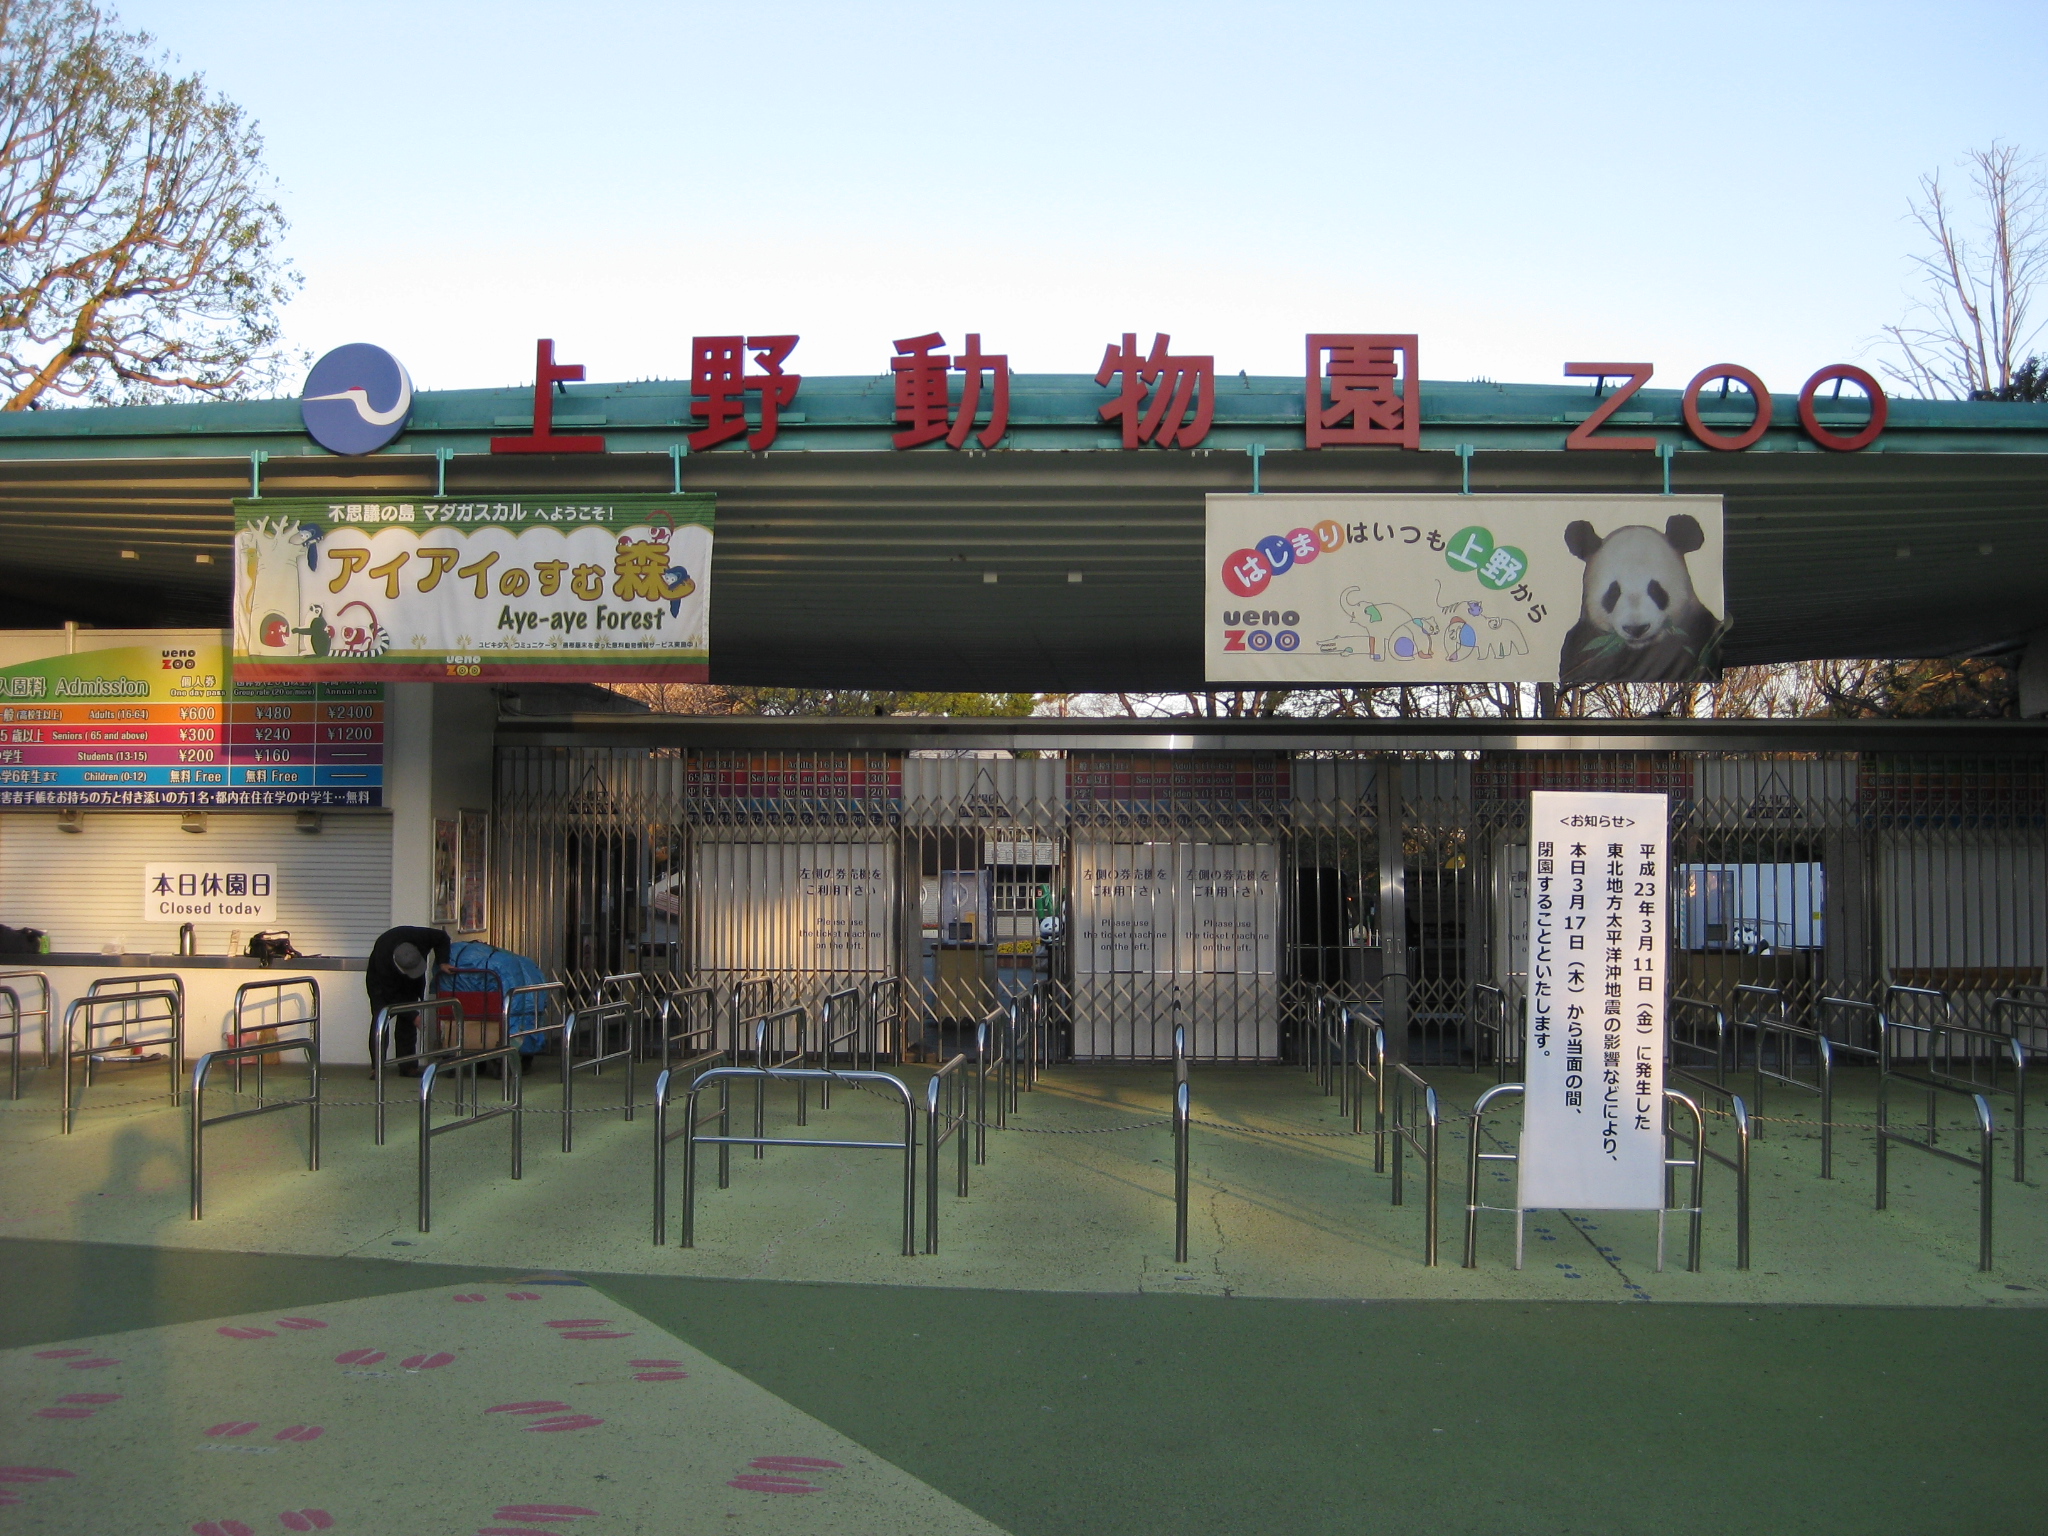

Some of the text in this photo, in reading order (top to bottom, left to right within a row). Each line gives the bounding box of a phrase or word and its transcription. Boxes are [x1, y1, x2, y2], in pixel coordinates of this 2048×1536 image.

[490, 333, 1887, 455] 上野動物園 ZOO
[328, 504, 415, 523] 不思議の島
[423, 503, 526, 522] マダガスカル
[327, 541, 696, 601] アイアイのすむ森
[1233, 519, 1548, 624] はじまりはいつも上野から
[497, 605, 666, 634] Aye-aye Forest
[1223, 610, 1300, 626] ueno
[1223, 630, 1300, 652] ZOO
[161, 650, 196, 658] ueno
[446, 656, 481, 664] ueno
[161, 659, 196, 670] ZOO
[446, 664, 481, 677] ZOO
[55, 676, 150, 698] Admission
[180, 676, 217, 689] 個人券
[170, 689, 226, 699] One day pass
[233, 689, 255, 697] Group
[325, 688, 355, 696] Annual
[0, 708, 15, 722] 般
[88, 710, 149, 721] Adults (16-64)
[179, 707, 215, 721] ¥600
[255, 706, 291, 720] ¥480
[327, 705, 373, 720] ¥2400
[12, 729, 44, 743] 歳以上
[52, 731, 83, 741] Seniors
[90, 731, 102, 741] 65
[104, 732, 119, 741] and
[121, 731, 149, 742] above)
[179, 728, 215, 742] ¥300
[255, 728, 291, 741] ¥240
[327, 727, 372, 741] ¥1200
[0, 749, 24, 764] 学生
[77, 751, 148, 762] Students (13-15)
[178, 749, 214, 763] ¥200
[254, 749, 290, 763] ¥160
[0, 769, 58, 785] 学6年生まで
[84, 771, 147, 782] Children (0-12)
[170, 769, 222, 783] 無料 Free
[245, 769, 298, 783] 無料 Free
[751, 774, 780, 783] Senors
[1136, 775, 1167, 784] Senors
[0, 790, 370, 806] 害者手帳をお持ちの方と付き添いの方1名・都内在住在学の中学生…無料
[151, 873, 271, 897] 本日休園日
[159, 901, 262, 917] Closed today
[1101, 919, 1131, 927] Plase
[1203, 919, 1233, 927] Plase
[844, 930, 881, 938] machne
[1132, 942, 1150, 951] eft.
[1235, 943, 1252, 951] eft.
[1534, 841, 1554, 1060] 閉園することといたします。
